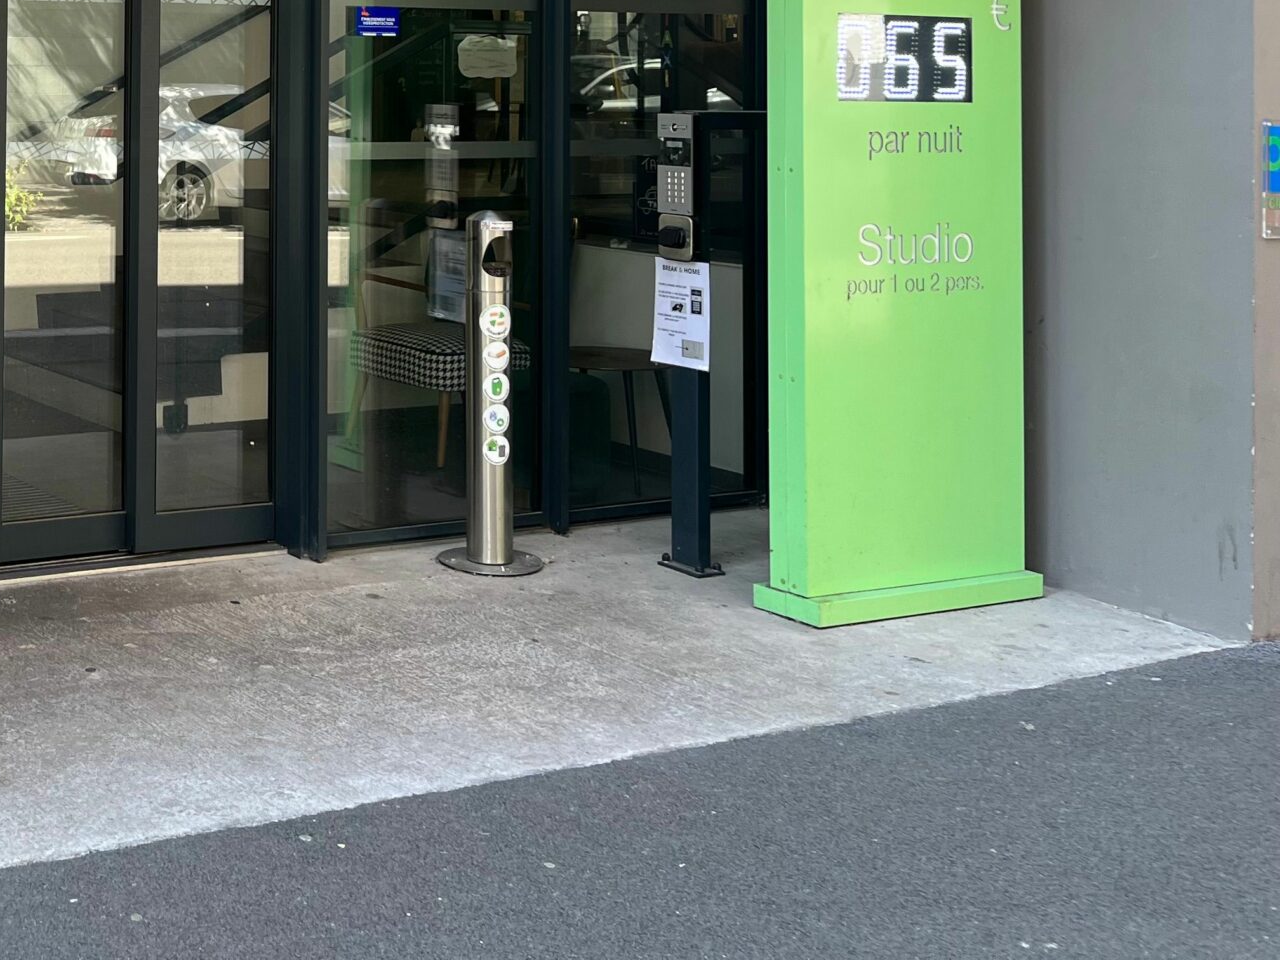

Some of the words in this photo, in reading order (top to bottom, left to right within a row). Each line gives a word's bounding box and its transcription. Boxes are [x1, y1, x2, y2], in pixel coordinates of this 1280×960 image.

[868, 129, 910, 161] par
[917, 124, 964, 154] nuit
[857, 222, 975, 267] Studio
[847, 276, 886, 302] pour
[890, 274, 898, 294] 1
[904, 276, 925, 293] ou
[930, 272, 940, 292] 2
[945, 273, 986, 297] pers.
